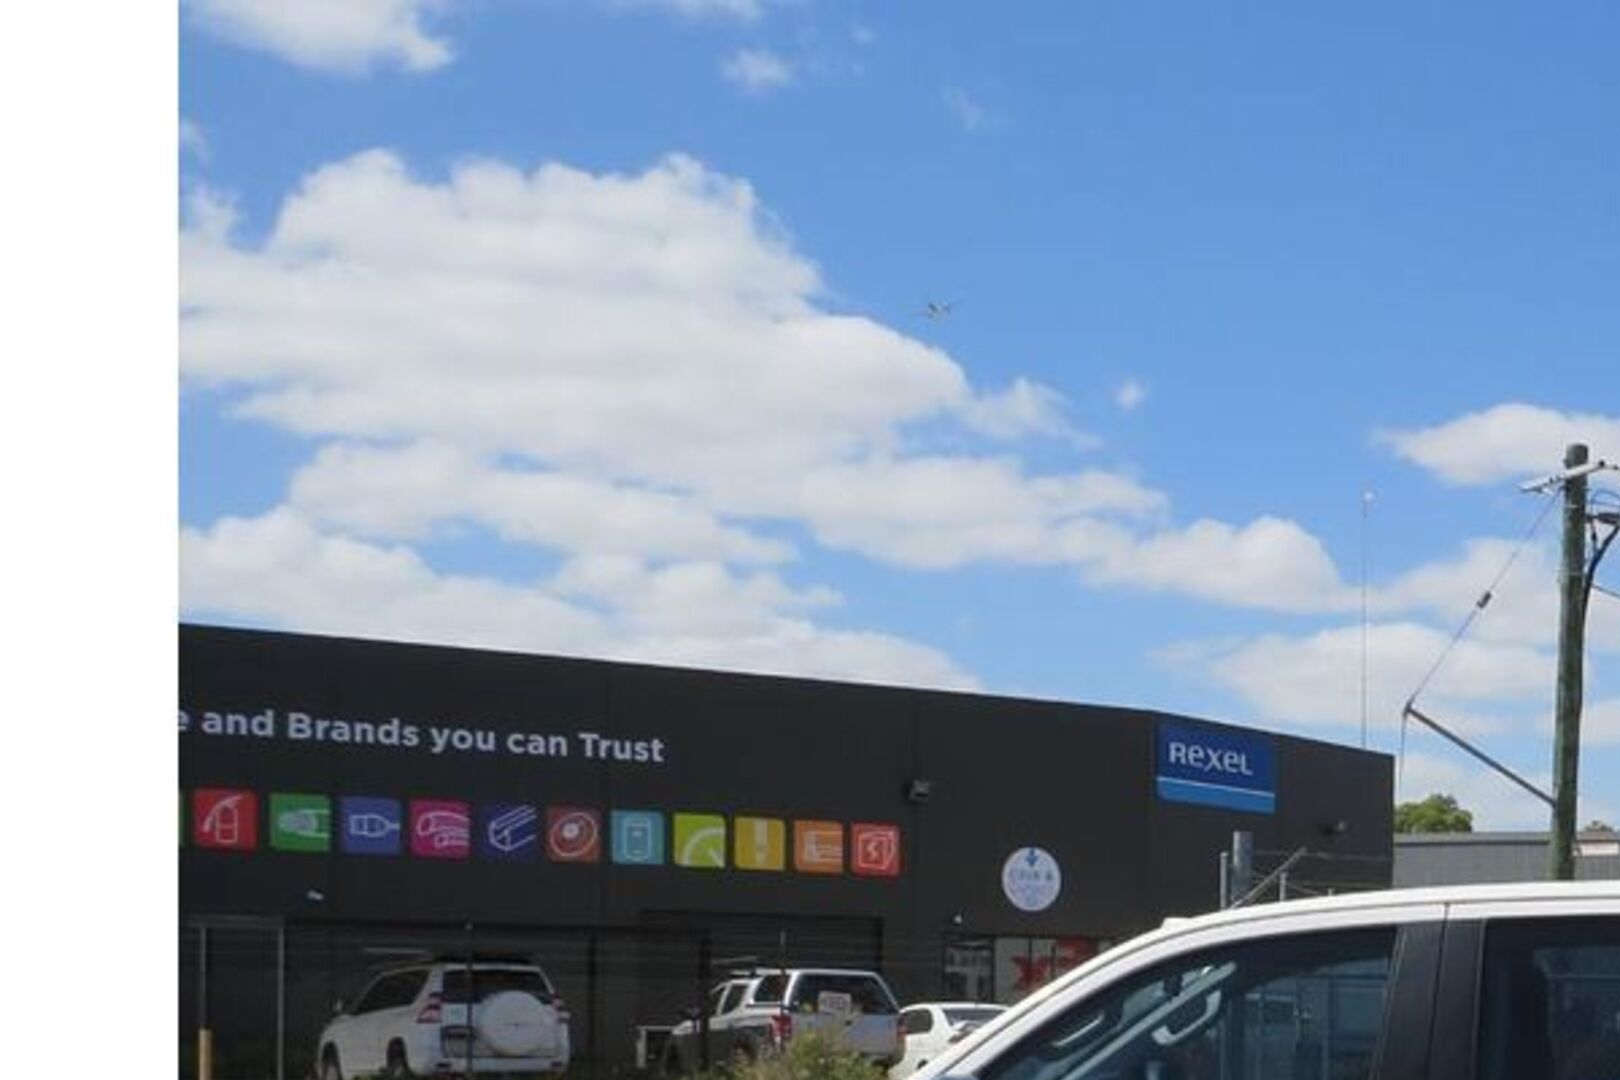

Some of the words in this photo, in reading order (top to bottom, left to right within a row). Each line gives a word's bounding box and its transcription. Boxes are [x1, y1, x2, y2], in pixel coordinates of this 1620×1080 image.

[201, 709, 275, 738] and
[287, 712, 419, 748] Brands
[430, 726, 495, 754] you
[505, 731, 569, 757] can
[578, 732, 666, 764] Trust
